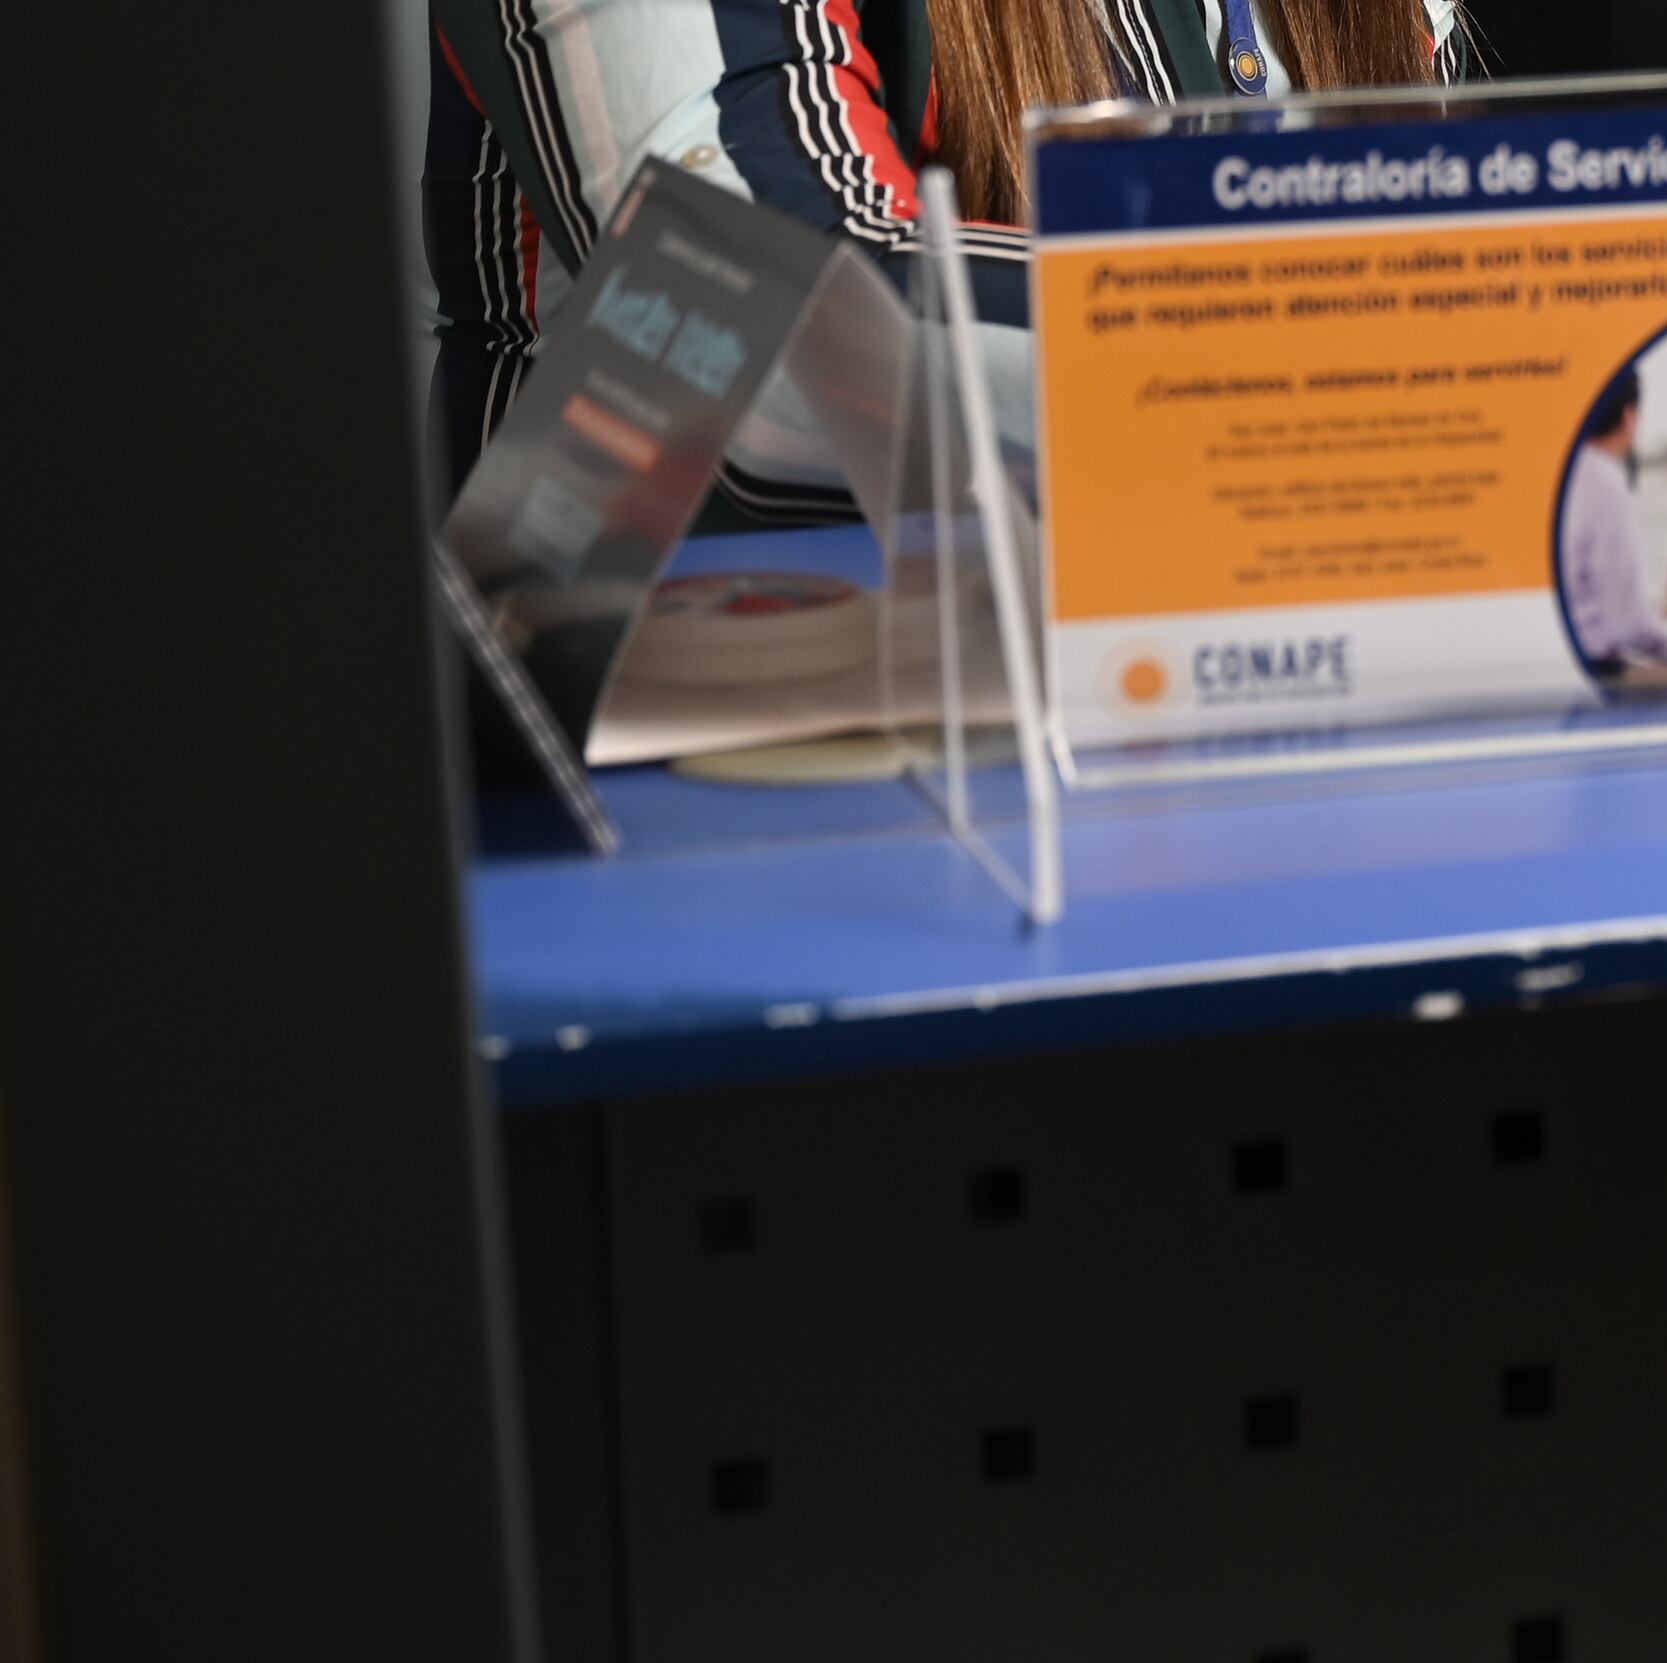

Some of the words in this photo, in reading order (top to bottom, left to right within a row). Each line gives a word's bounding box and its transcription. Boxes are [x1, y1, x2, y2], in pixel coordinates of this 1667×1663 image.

[1212, 144, 1471, 211] Contraloría
[1478, 141, 1539, 196] de
[1193, 634, 1354, 690] CONAPE
